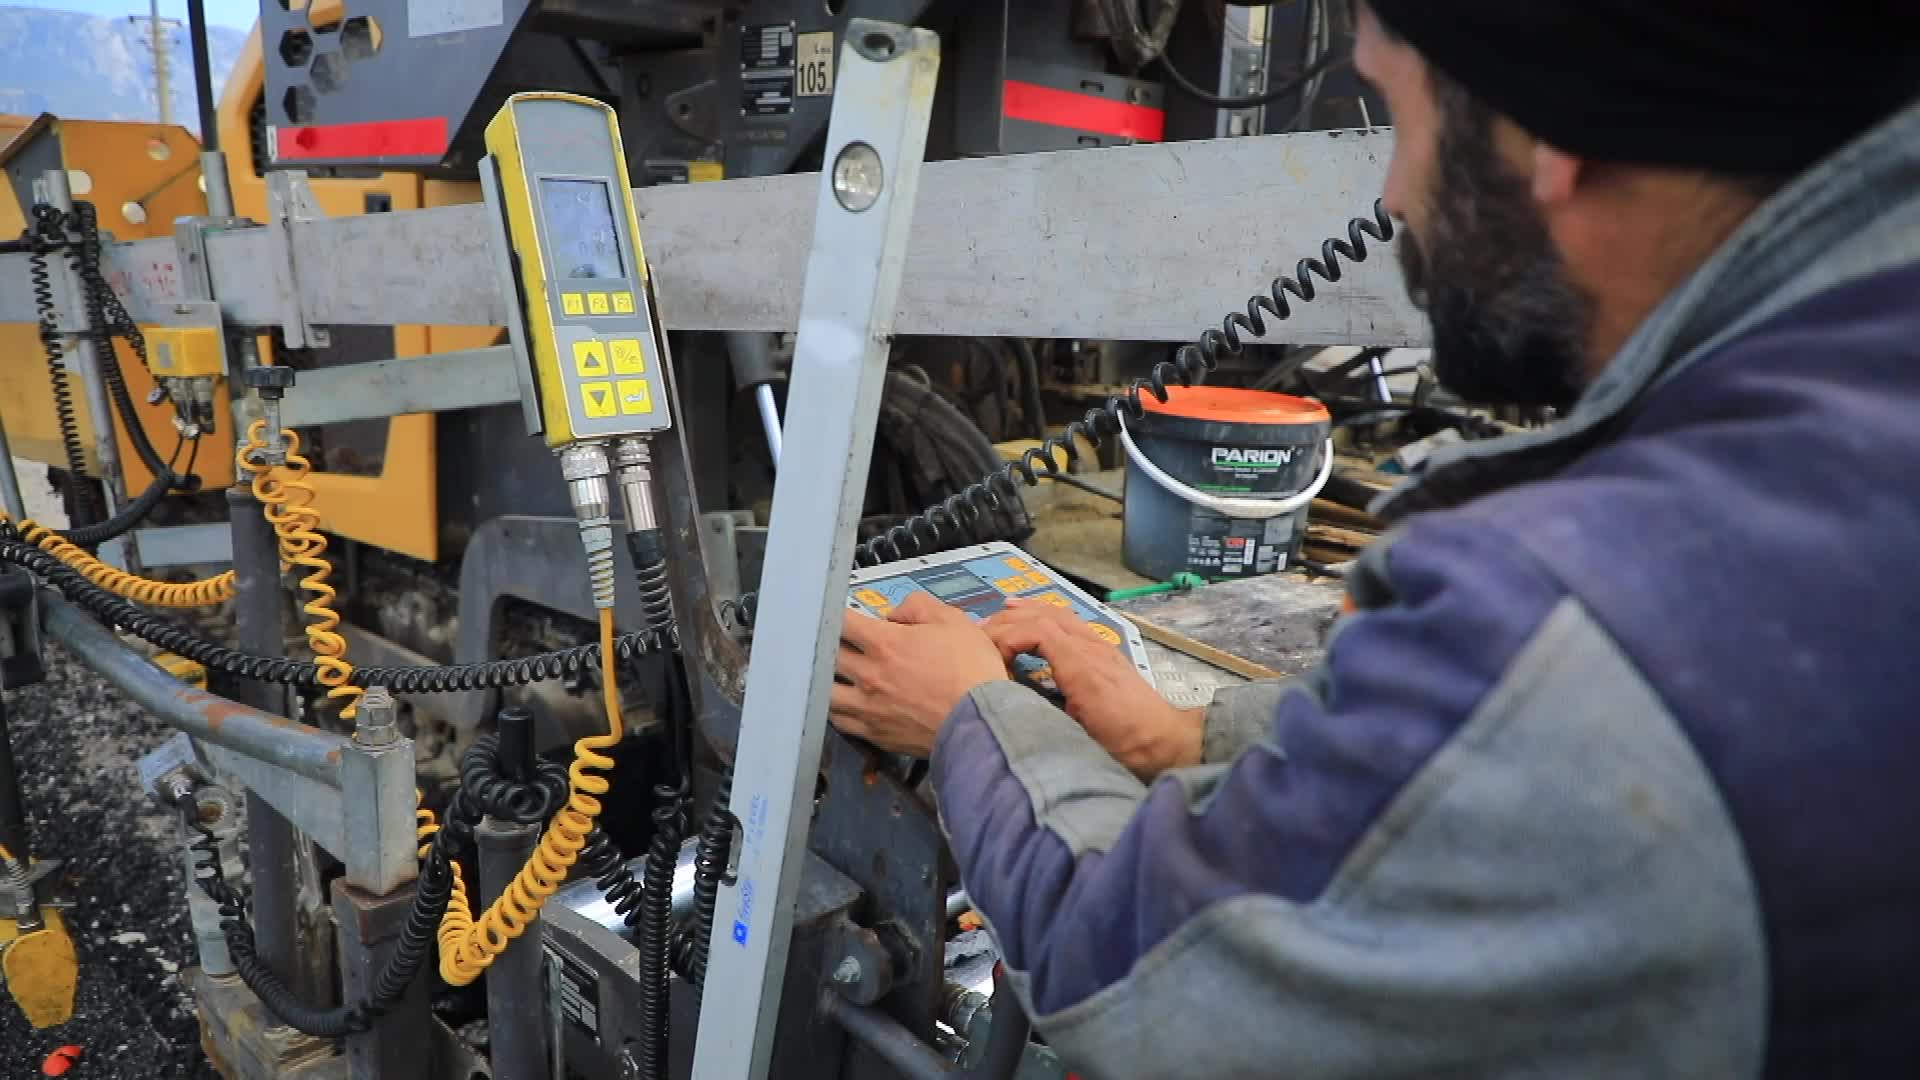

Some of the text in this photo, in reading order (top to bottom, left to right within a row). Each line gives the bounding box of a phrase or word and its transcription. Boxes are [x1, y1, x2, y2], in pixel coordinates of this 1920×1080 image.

[799, 61, 826, 93] 105
[593, 298, 606, 311] F2
[617, 298, 631, 311] F3
[1211, 448, 1291, 464] PARION
